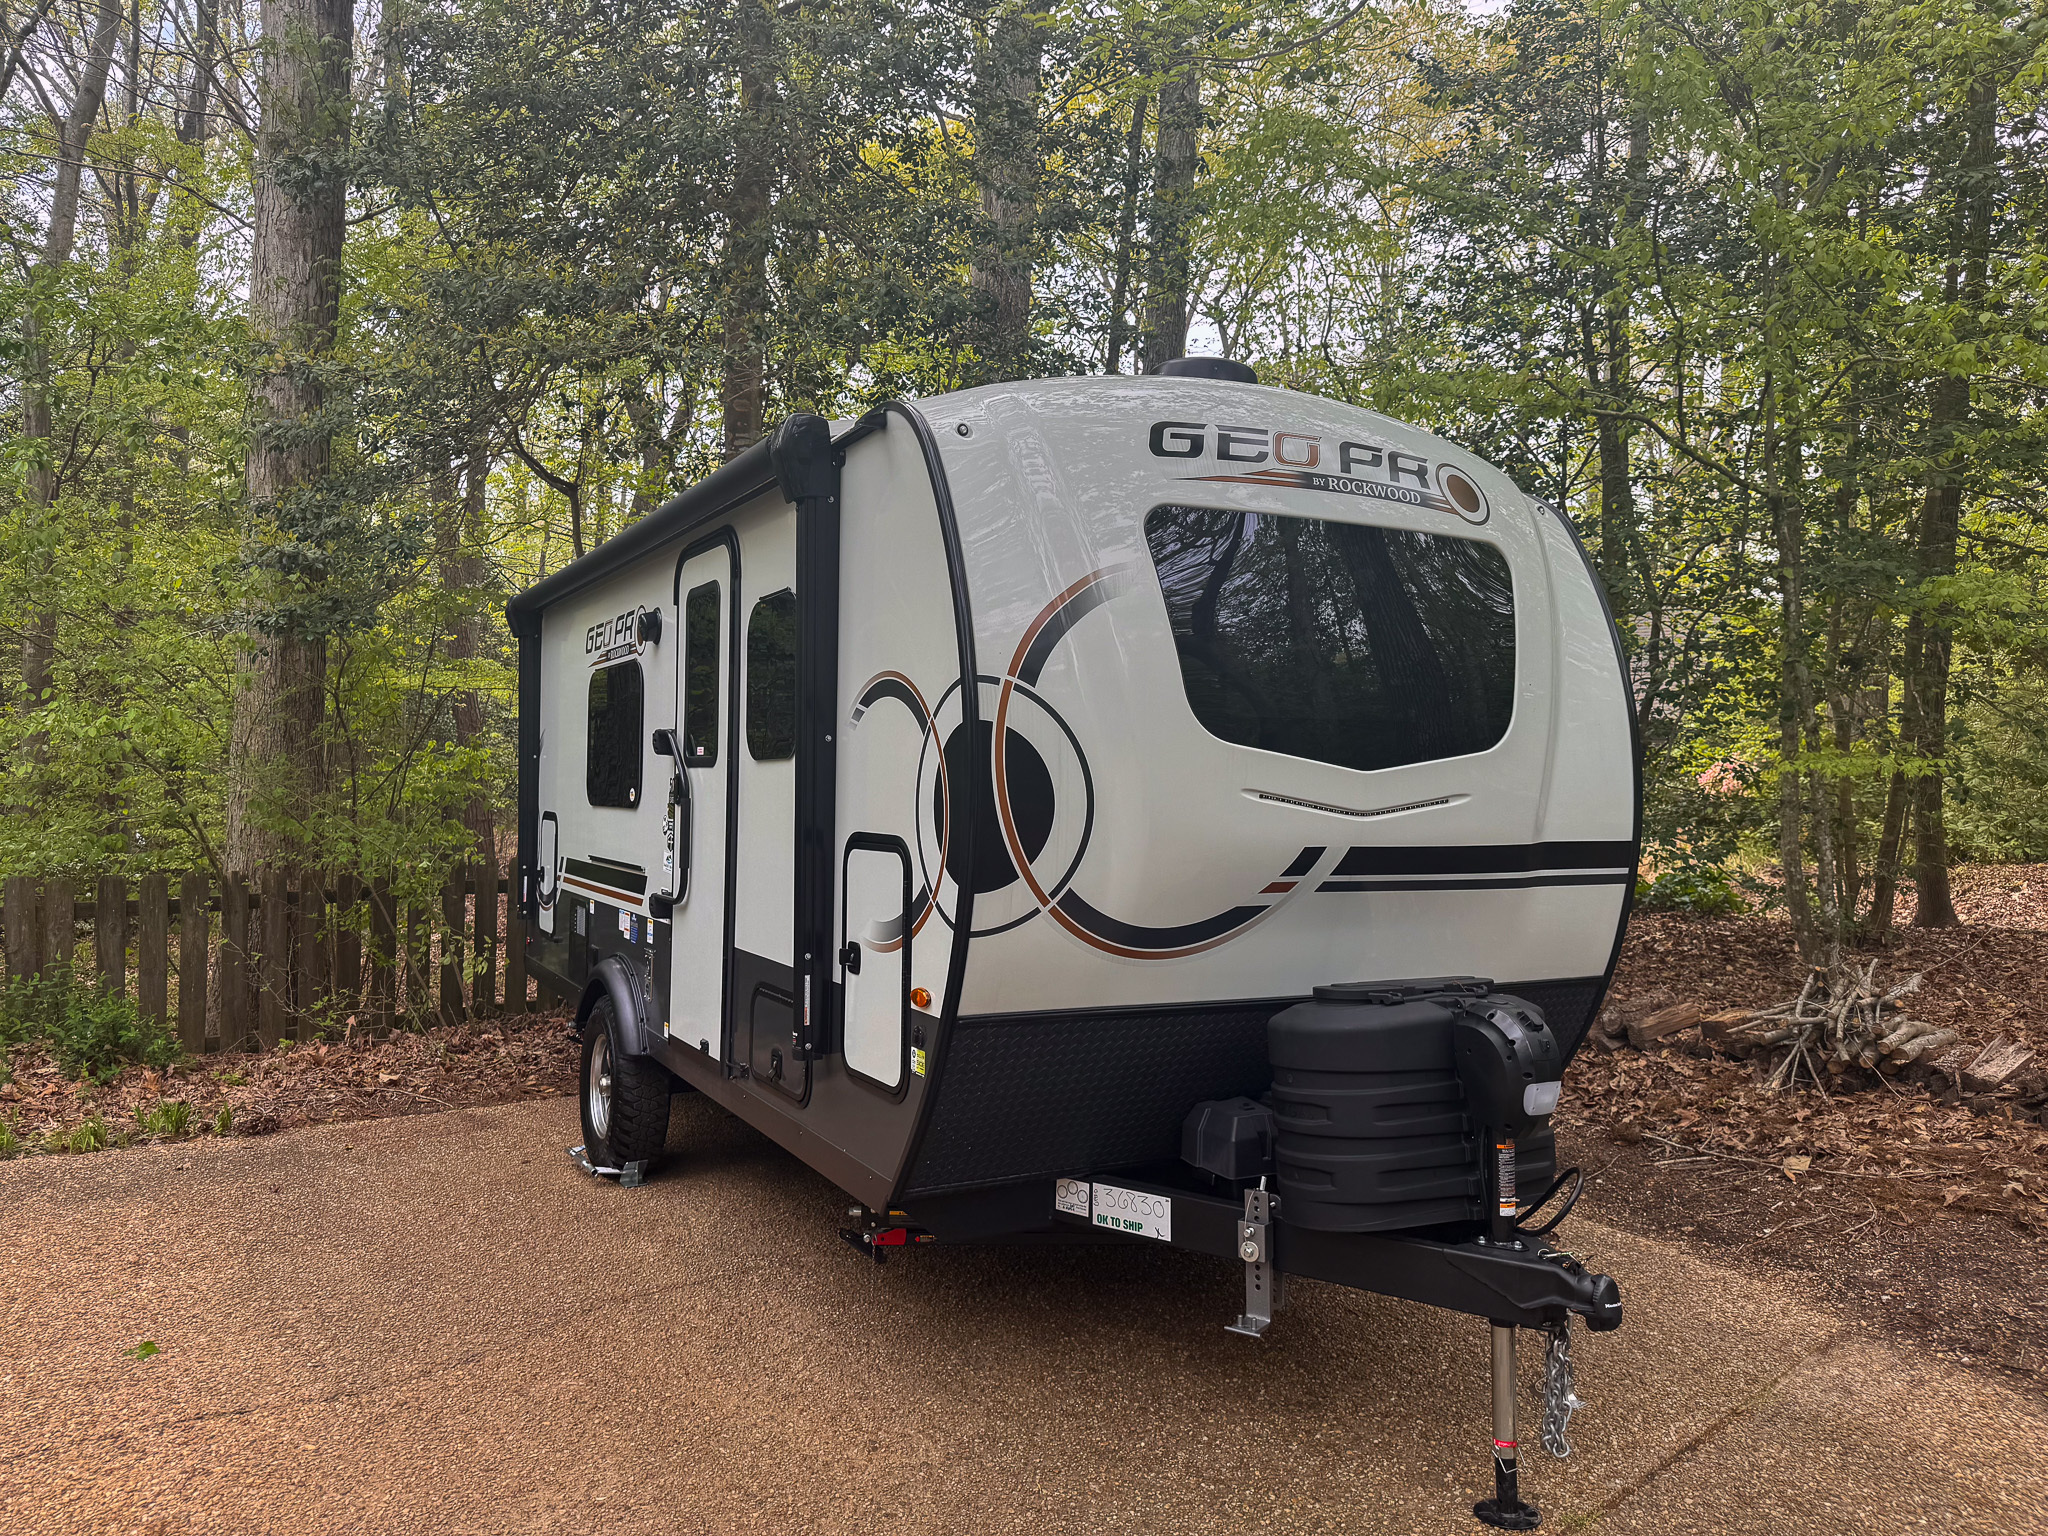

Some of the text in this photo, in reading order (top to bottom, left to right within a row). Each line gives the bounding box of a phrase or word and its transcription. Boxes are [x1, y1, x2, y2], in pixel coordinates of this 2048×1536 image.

[1148, 420, 1321, 469] GEO
[1312, 476, 1421, 504] BY ROCKWOOD
[585, 618, 614, 655] GEO
[1103, 1188, 1164, 1218] 36830
[1096, 1213, 1143, 1233] OK TO SHIP
